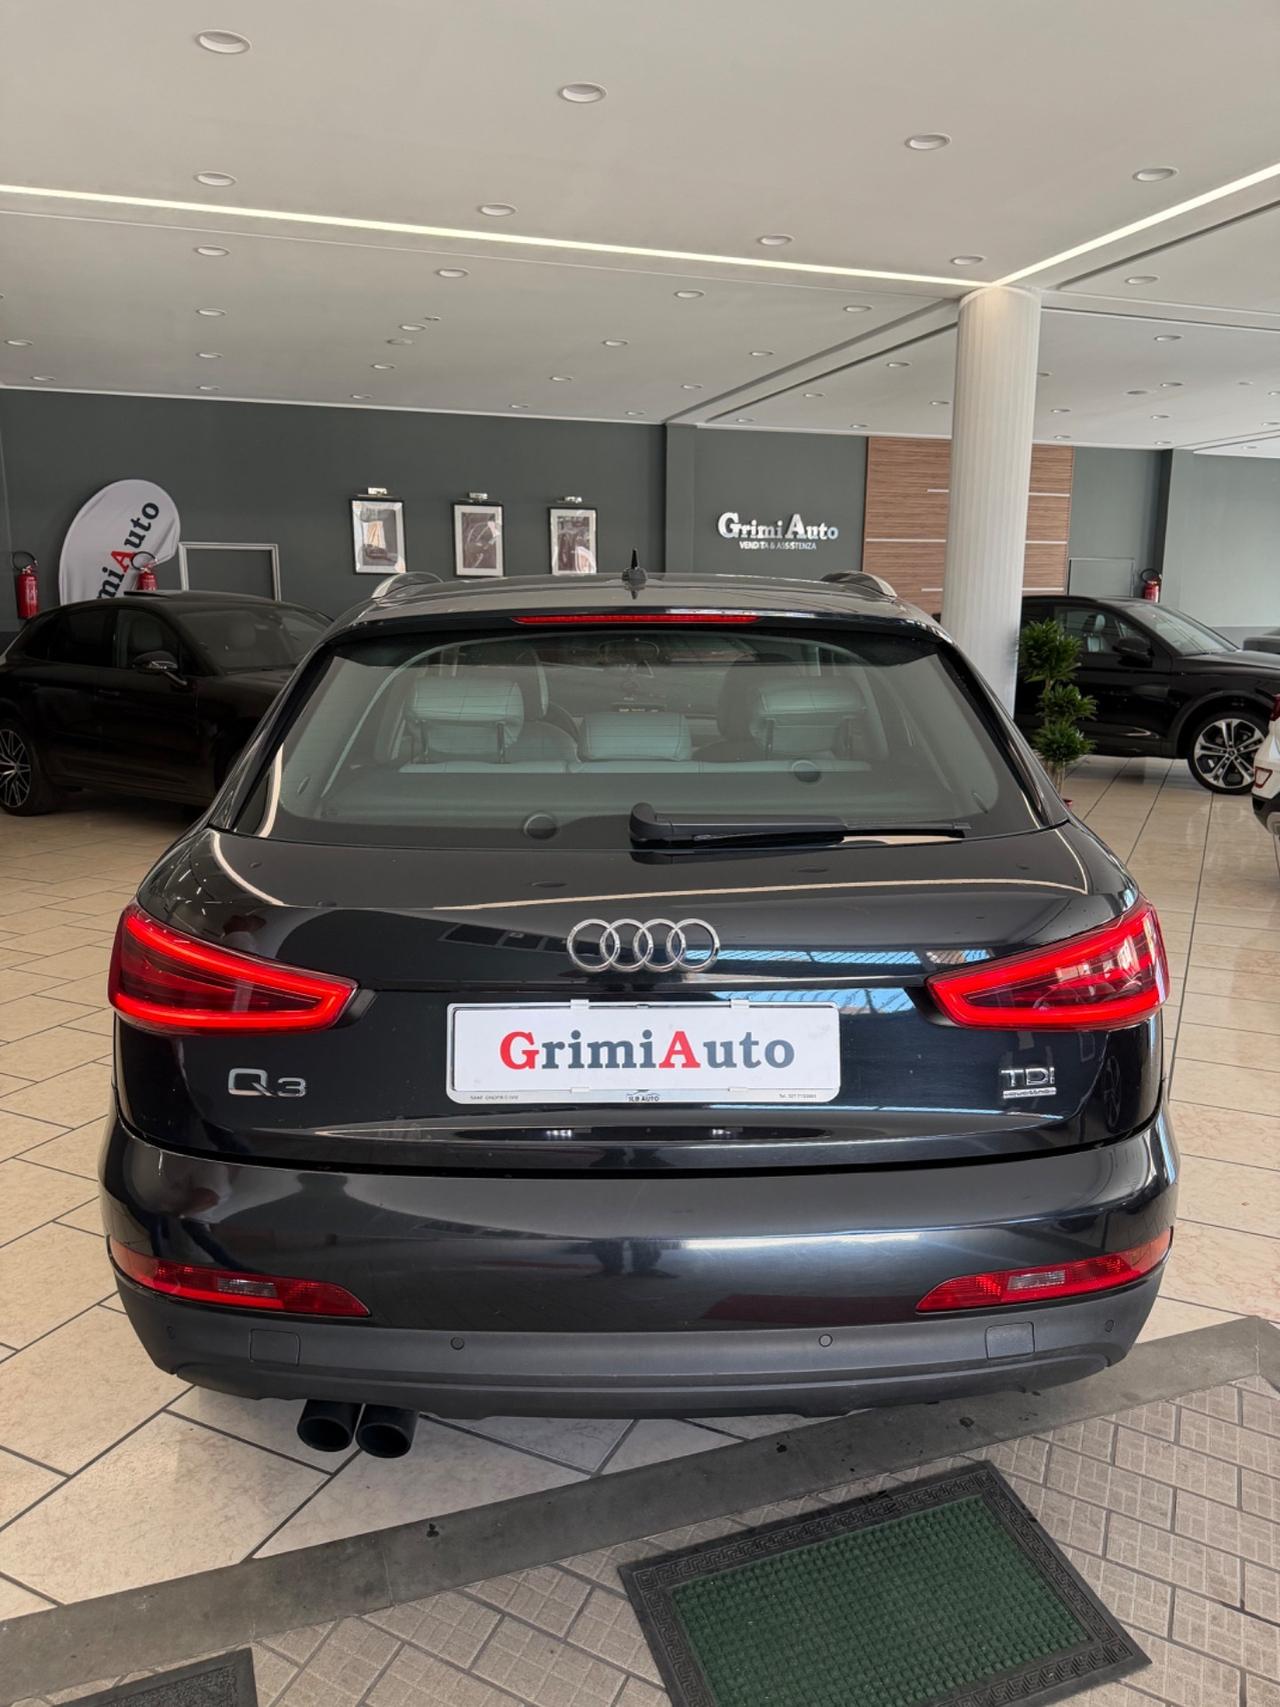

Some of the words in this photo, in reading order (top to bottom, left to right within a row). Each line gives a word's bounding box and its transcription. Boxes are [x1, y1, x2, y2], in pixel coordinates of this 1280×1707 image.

[97, 502, 160, 599] miAuto
[739, 541, 769, 550] VENDITA
[776, 541, 817, 550] ASSISTENZA
[499, 1029, 795, 1071] GrimiAuto
[228, 1068, 306, 1098] Q3
